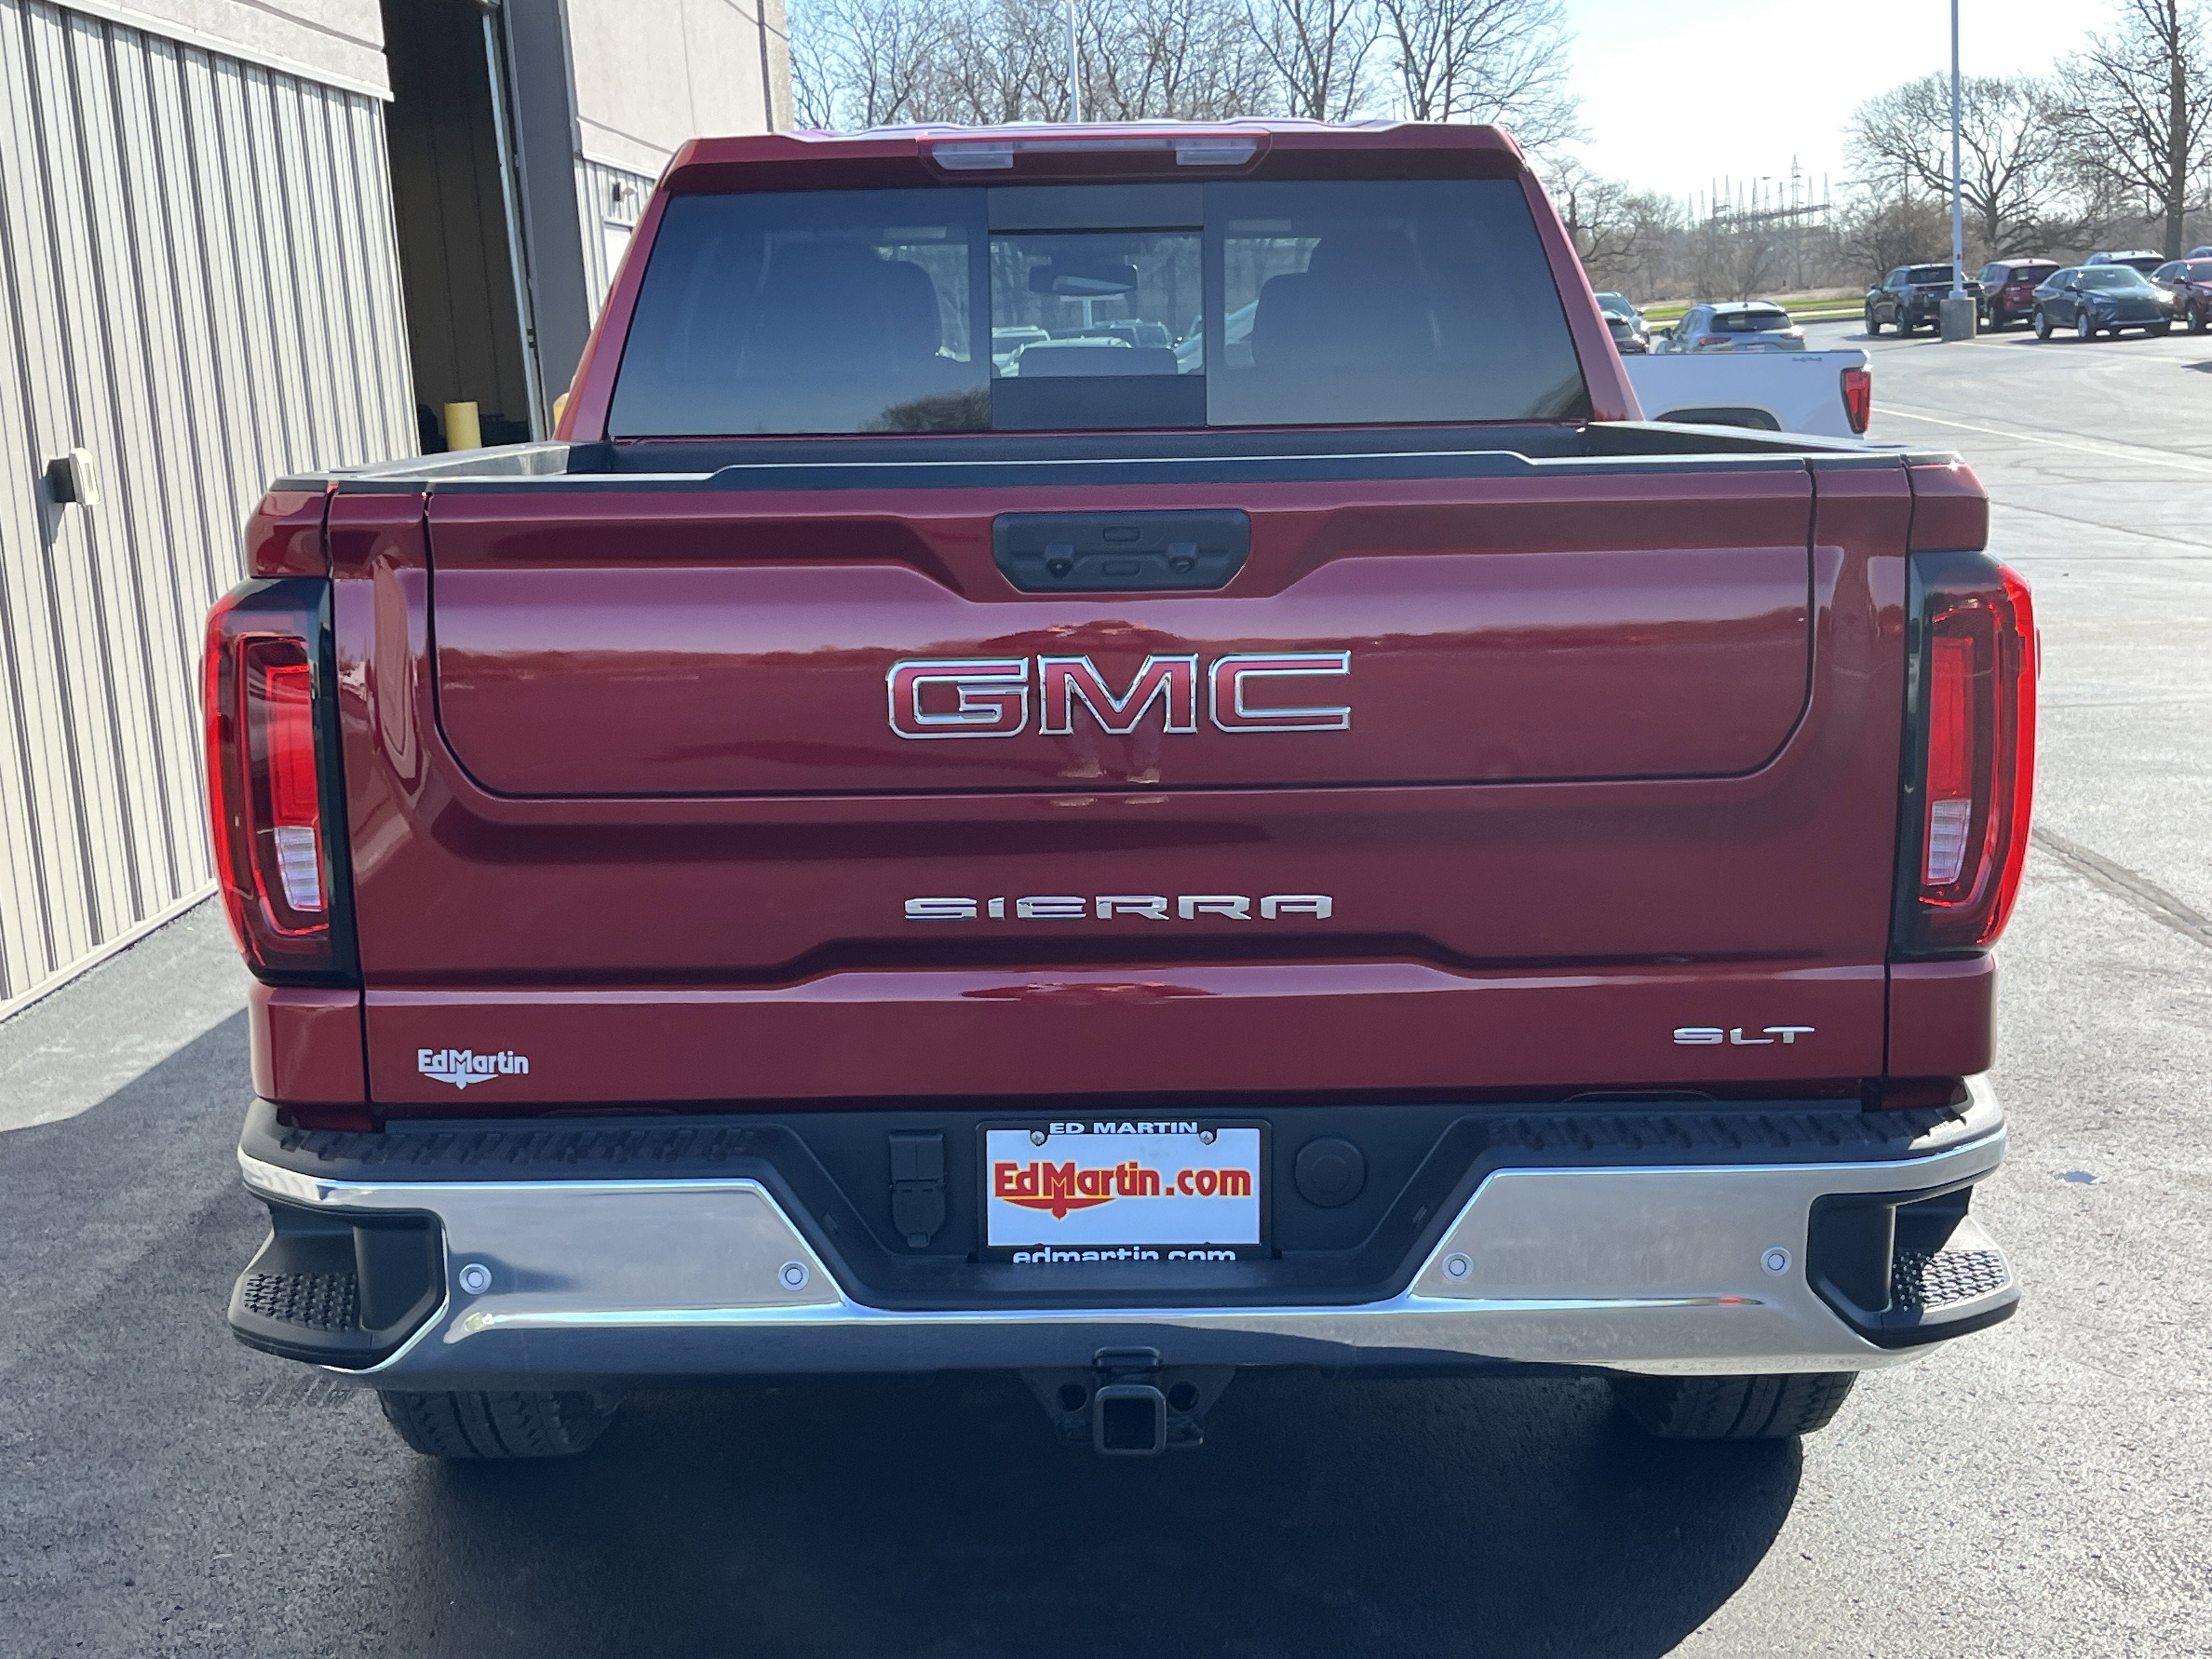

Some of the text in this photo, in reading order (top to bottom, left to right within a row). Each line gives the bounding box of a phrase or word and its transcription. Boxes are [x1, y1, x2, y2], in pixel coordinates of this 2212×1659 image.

[885, 651, 1351, 739] GMC
[904, 895, 1333, 920] SIERRA
[1673, 1025, 1815, 1045] SLT
[417, 1048, 530, 1075] EdMartin
[1049, 1121, 1198, 1135] ED MARTIN
[994, 1160, 1251, 1198] EdMartin.com
[1013, 1246, 1236, 1264] edmartincom
